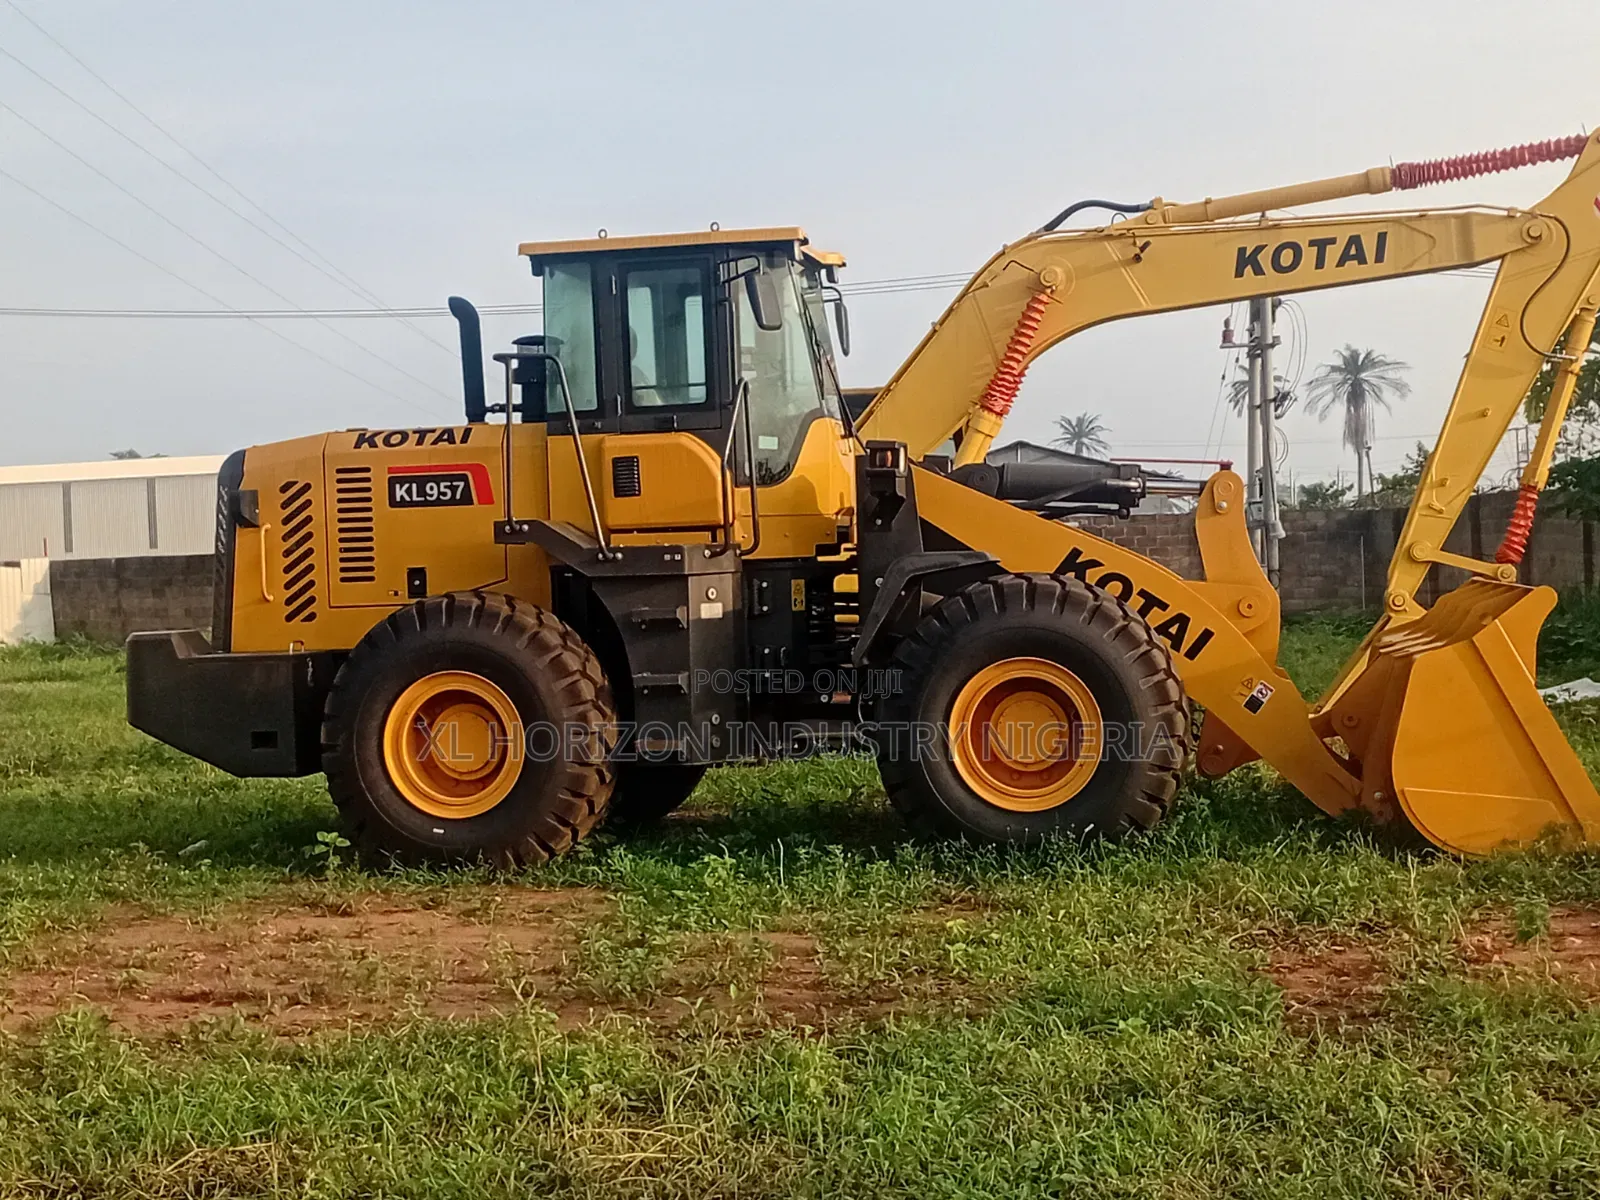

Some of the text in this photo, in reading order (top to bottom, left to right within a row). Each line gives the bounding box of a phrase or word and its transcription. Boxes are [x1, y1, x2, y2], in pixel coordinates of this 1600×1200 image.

[1234, 231, 1388, 279] KOTAI
[353, 427, 473, 449] KOTAI
[395, 481, 465, 502] KL957
[1052, 546, 1215, 661] KOTAI
